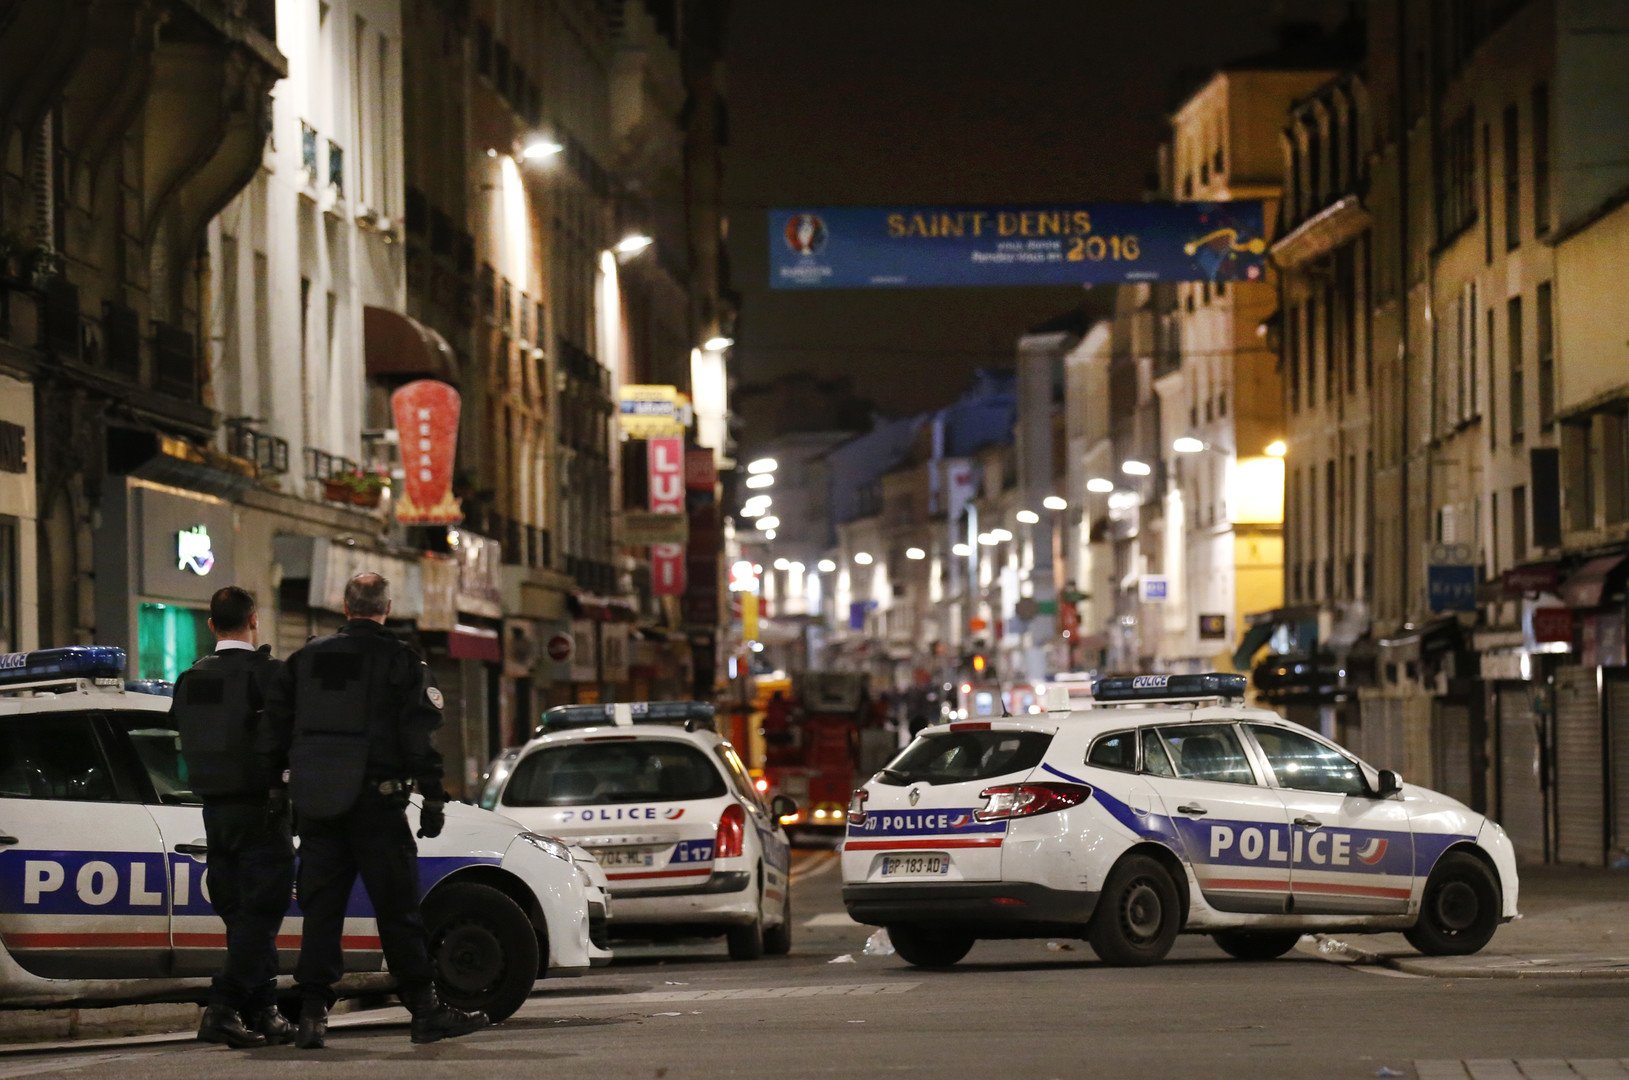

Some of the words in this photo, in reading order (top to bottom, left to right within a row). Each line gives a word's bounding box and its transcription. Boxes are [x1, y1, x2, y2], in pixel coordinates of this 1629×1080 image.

[1067, 235, 1141, 262] 2016
[1134, 675, 1167, 687] POLICE
[562, 807, 657, 823] POLICE
[882, 814, 948, 830] POLICE
[1209, 825, 1351, 866] POLICE
[690, 847, 712, 861] 17
[24, 860, 212, 906] POLI
